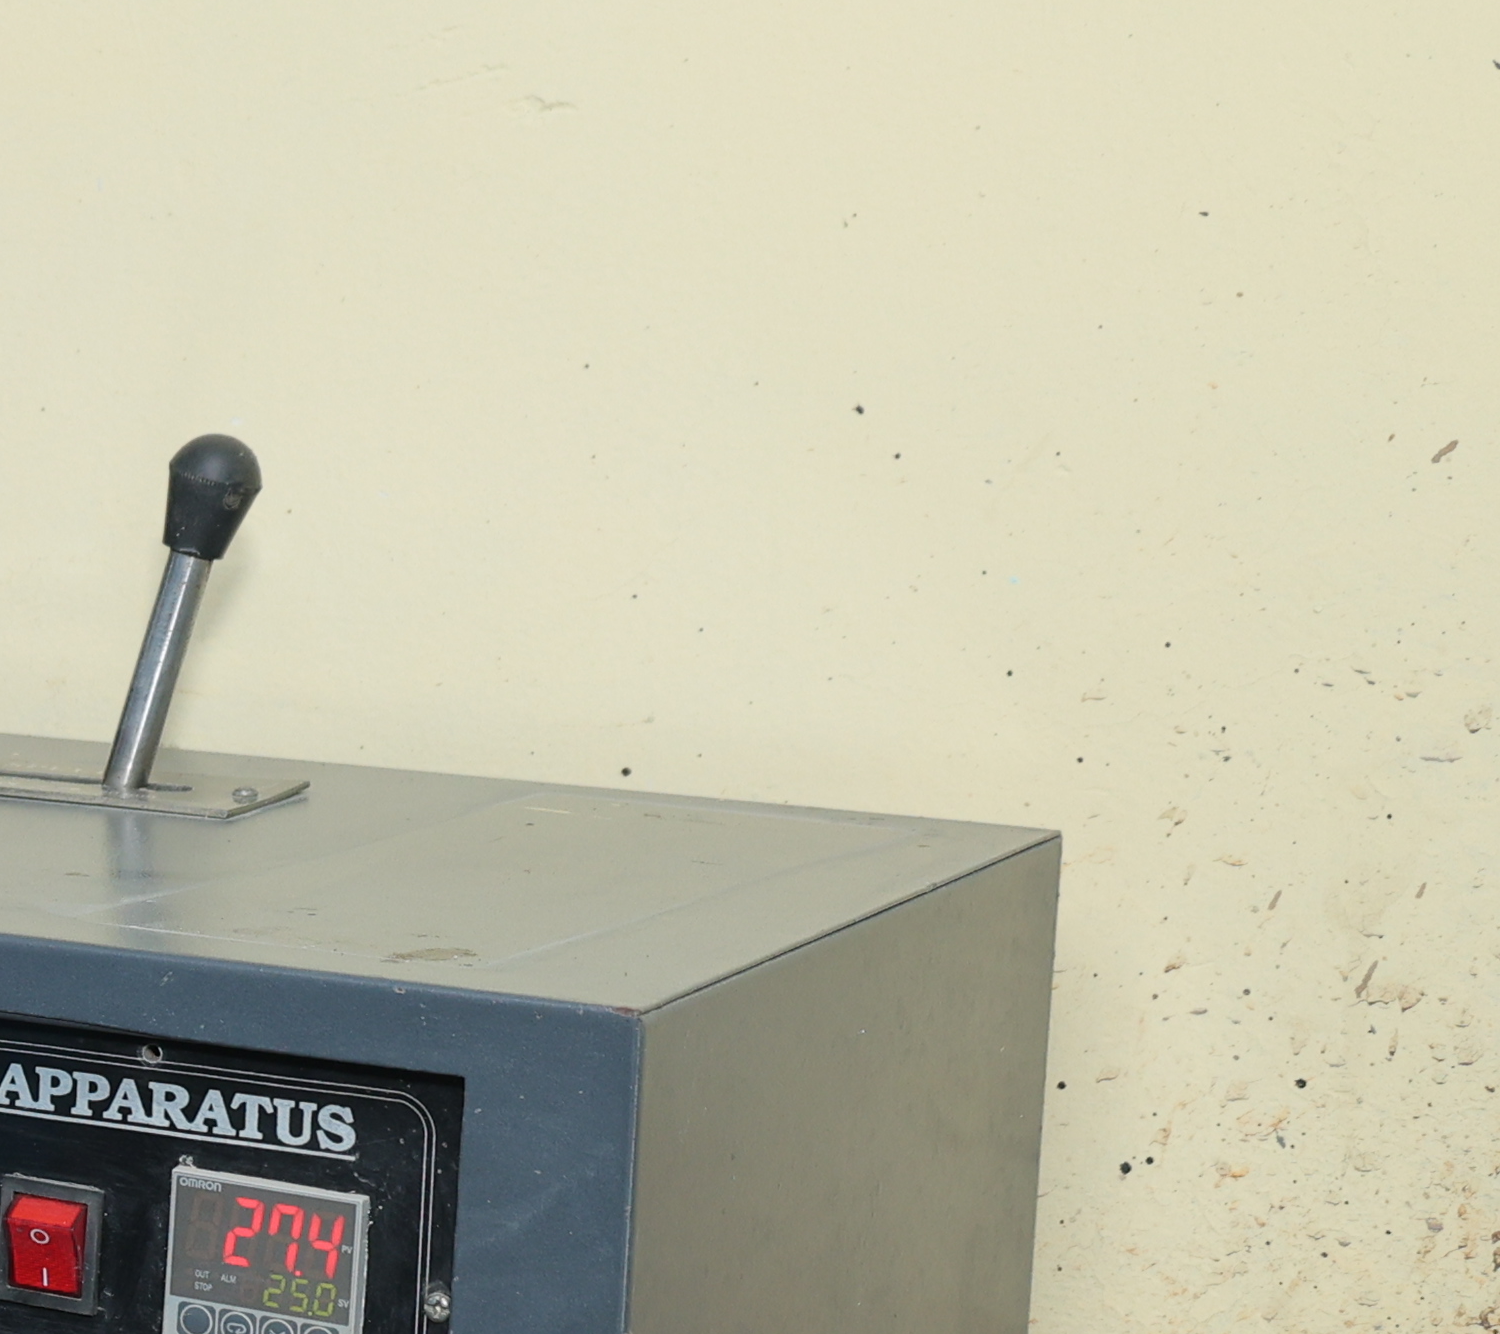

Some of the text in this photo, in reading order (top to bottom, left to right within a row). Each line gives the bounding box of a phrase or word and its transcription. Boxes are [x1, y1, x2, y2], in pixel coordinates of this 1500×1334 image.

[179, 1177, 222, 1193] OMRON
[222, 1196, 345, 1280] 27.4
[262, 1273, 338, 1317] 25.0
